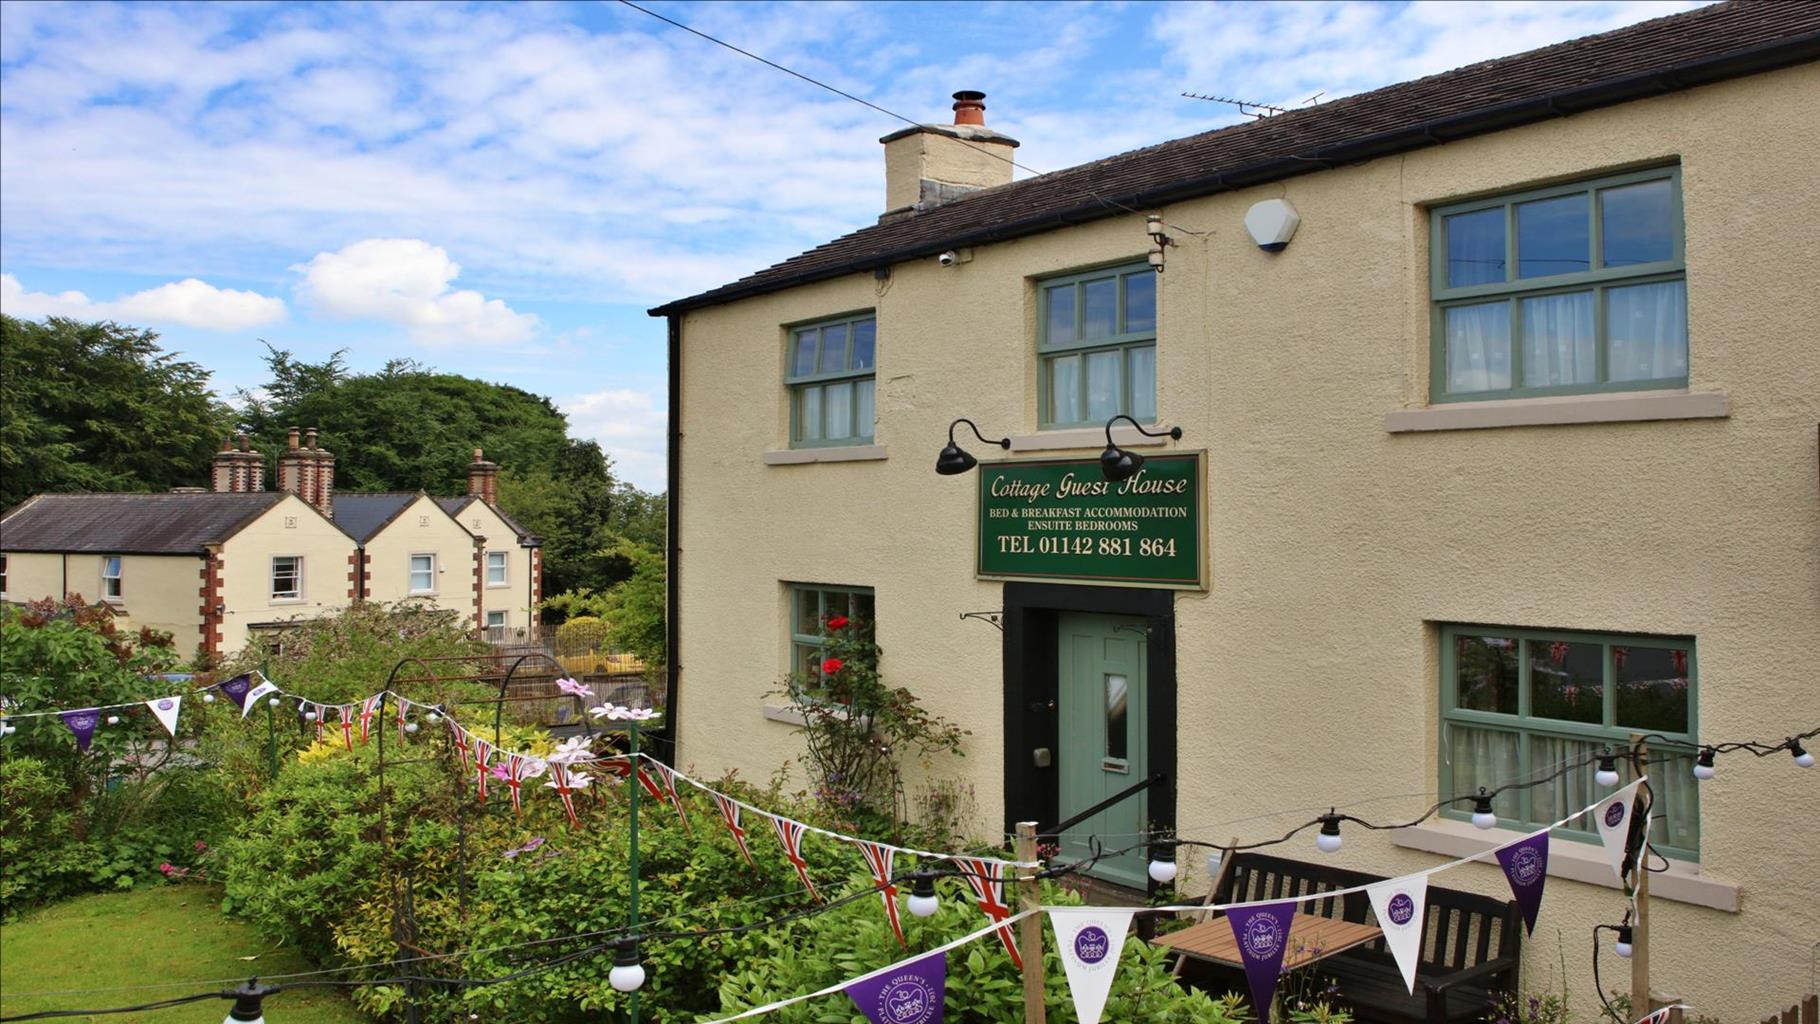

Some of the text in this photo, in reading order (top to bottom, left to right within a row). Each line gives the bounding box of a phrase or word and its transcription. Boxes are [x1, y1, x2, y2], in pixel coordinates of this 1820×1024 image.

[991, 469, 1187, 503] Cottage Guest House
[989, 506, 1187, 518] BED & BREAKFAST ACCOMMODATION
[1027, 520, 1138, 531] ENSUITE BEDROOMS
[997, 535, 1177, 557] TEL 01142 881 864
[879, 984, 891, 999] THE
